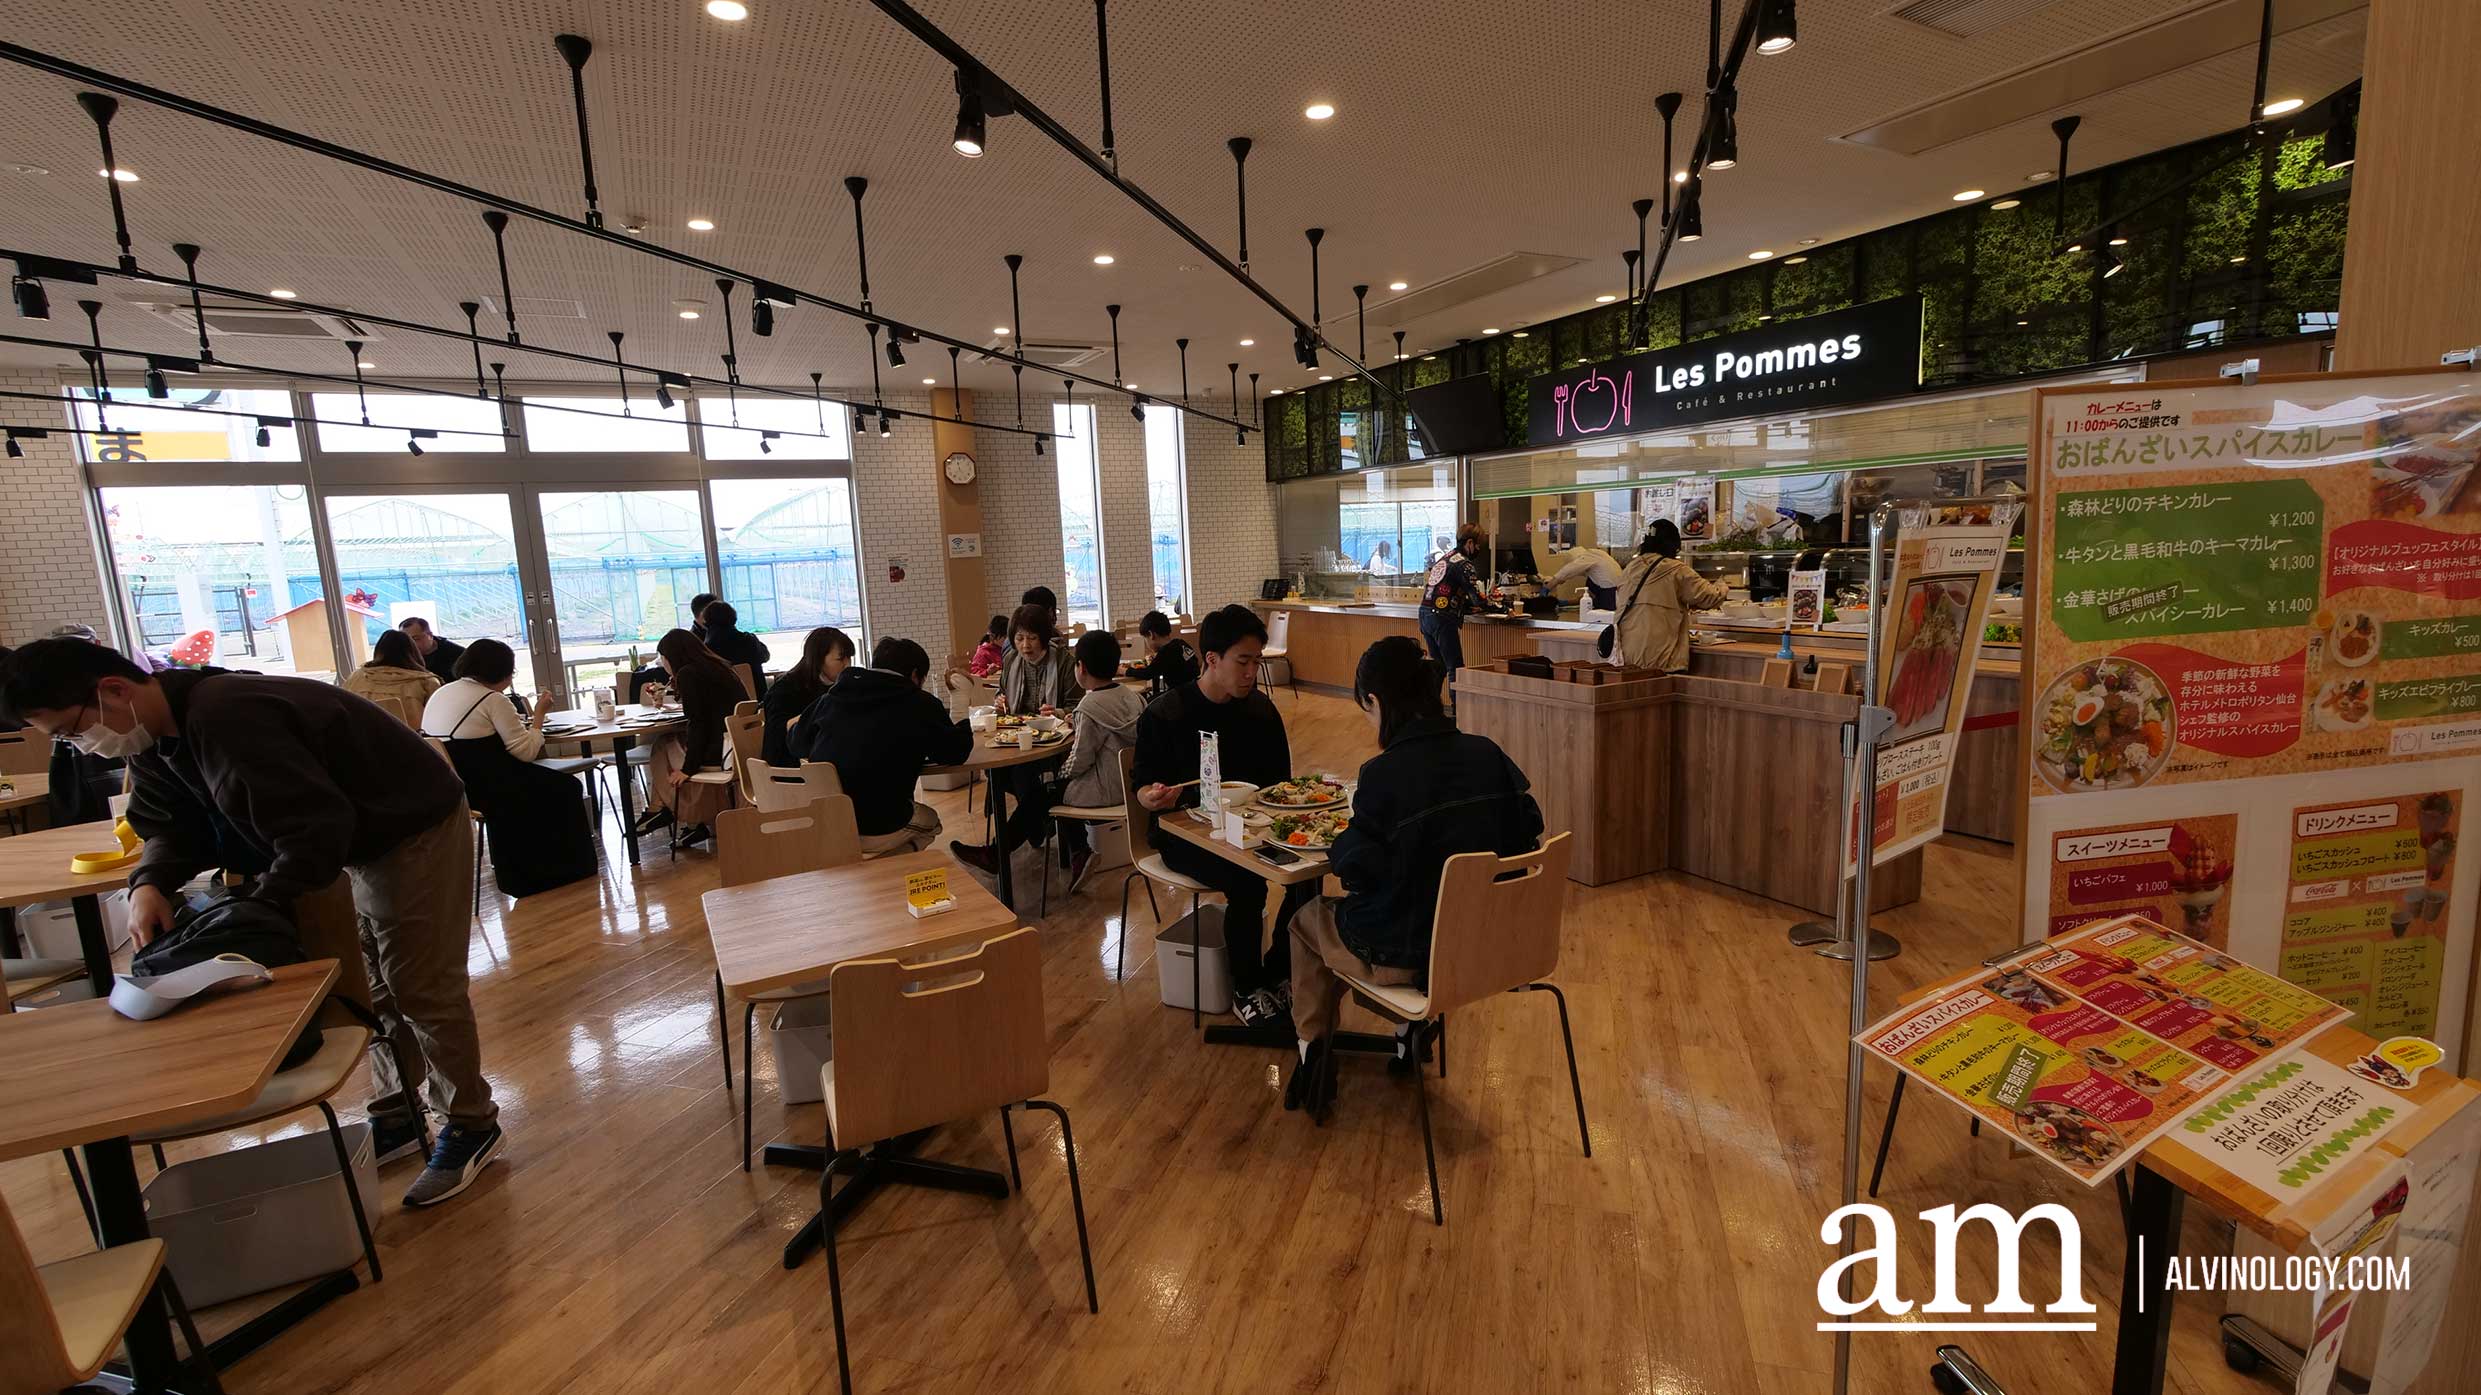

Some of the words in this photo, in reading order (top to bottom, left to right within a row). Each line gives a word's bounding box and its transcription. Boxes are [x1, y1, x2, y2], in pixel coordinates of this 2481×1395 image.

[1655, 363, 1706, 393] Les
[1714, 334, 1862, 383] Pommes
[1676, 397, 1708, 410] Café
[1718, 395, 1726, 404] &
[1737, 377, 1837, 401] Restaurant
[2087, 399, 2162, 415] カレーメニューは
[2066, 414, 2181, 433] 11:00からのご提供です
[2057, 425, 2362, 470] おばんざいスパイスカレー
[2268, 511, 2316, 528] ¥1,200
[1949, 547, 1964, 557] Les
[1965, 546, 1998, 557] Pommes
[2268, 554, 2315, 571] ¥1,300
[2106, 584, 2180, 618] 販売期間終了
[2267, 598, 2313, 614] ¥1,400
[2408, 622, 2470, 637] キッズカレー
[2454, 634, 2480, 648] ¥500
[2181, 664, 2281, 683] 季節の新鮮な野菜を
[2180, 681, 2257, 698] 存分に味わえる
[2179, 693, 2297, 712] ホテルメトロポリタン仙台
[2451, 695, 2477, 708] ¥800
[2179, 711, 2241, 726] シェフ監修の
[2179, 722, 2300, 742] オリジナルスパイスカレー
[2305, 814, 2391, 832] ドリンクメニュー
[2067, 838, 2166, 857] スイーツメニュー
[1996, 1047, 2041, 1106] 販売期間終了
[2210, 1079, 2325, 1151] おばんざいの取り分けは
[2256, 1086, 2365, 1158] 1回限りとさせて頂きます
